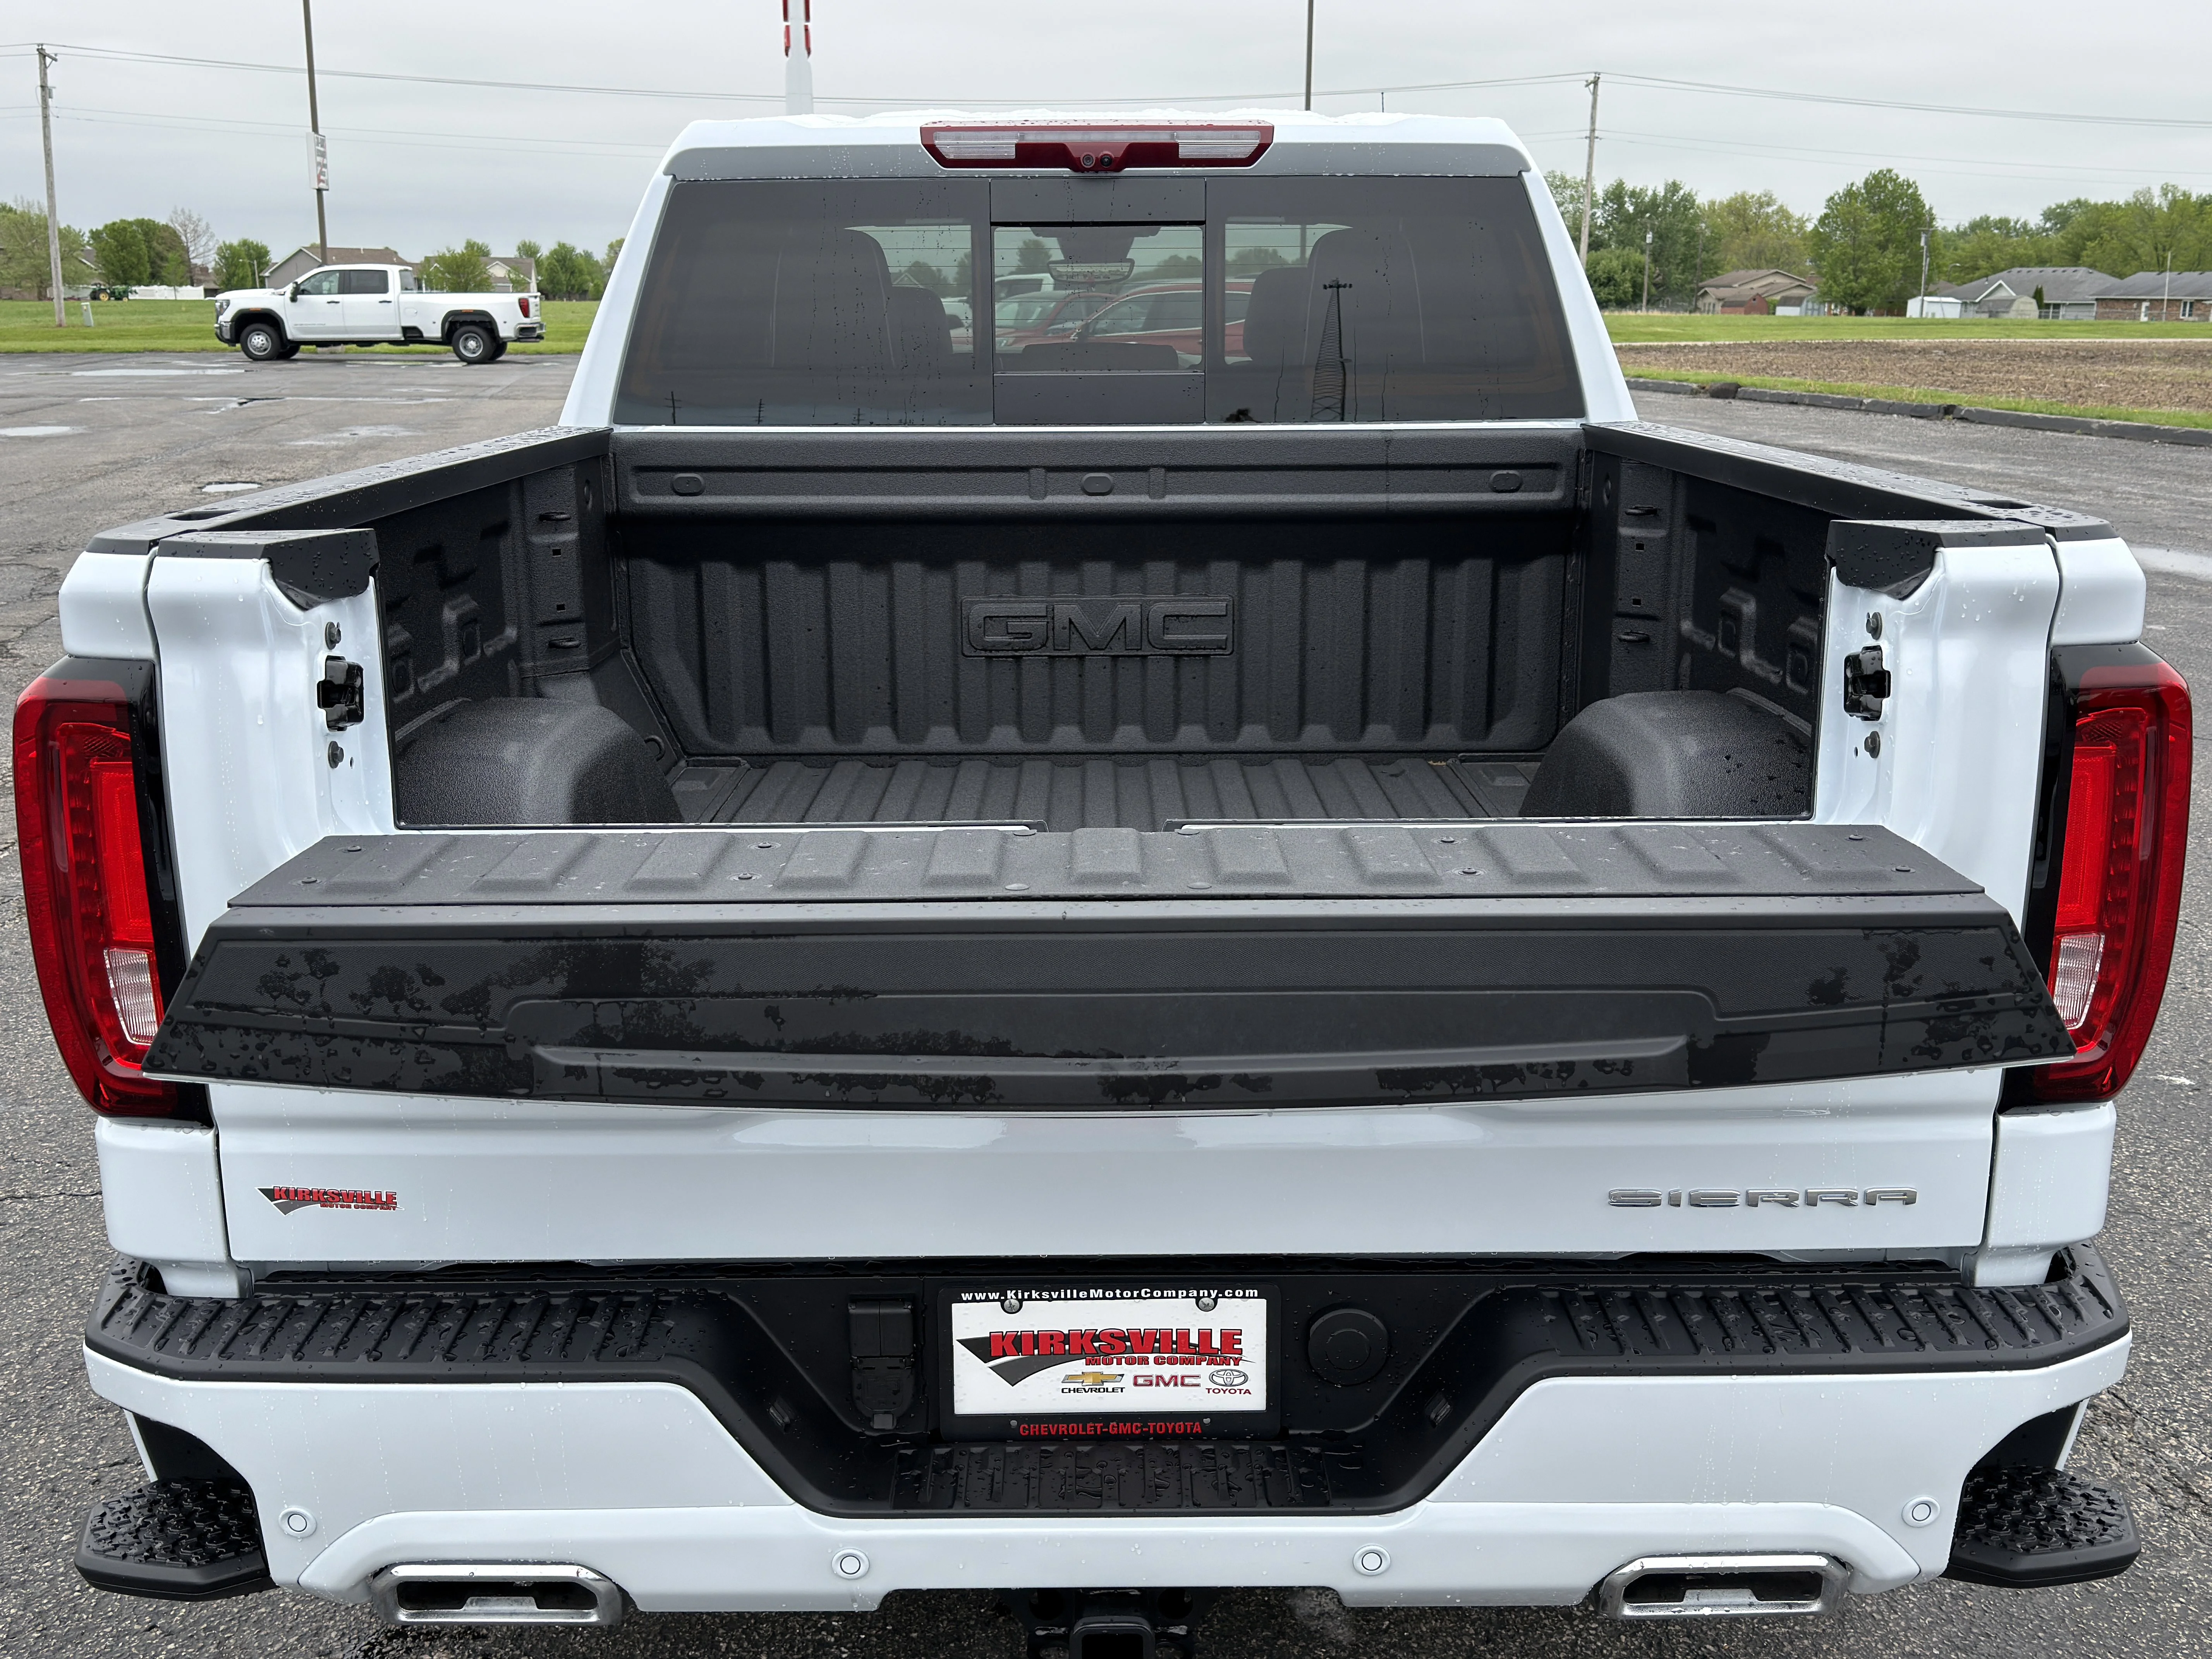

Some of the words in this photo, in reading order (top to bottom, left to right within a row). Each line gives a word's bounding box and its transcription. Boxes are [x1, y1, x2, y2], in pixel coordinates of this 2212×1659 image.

[969, 602, 1228, 651] GMC
[273, 1186, 397, 1205] KIRKSVILLE
[1609, 1187, 1918, 1208] SIERRA
[961, 1288, 1258, 1300] www.KirksvilleMotorCompany.com
[989, 1328, 1243, 1357] KIRKSVILLE
[1085, 1356, 1149, 1366] MOTOR
[1153, 1356, 1242, 1366] COMPANY
[1132, 1374, 1201, 1388] GMC
[1019, 1422, 1202, 1436] CHEVROLET-GMC-TOYOTA
